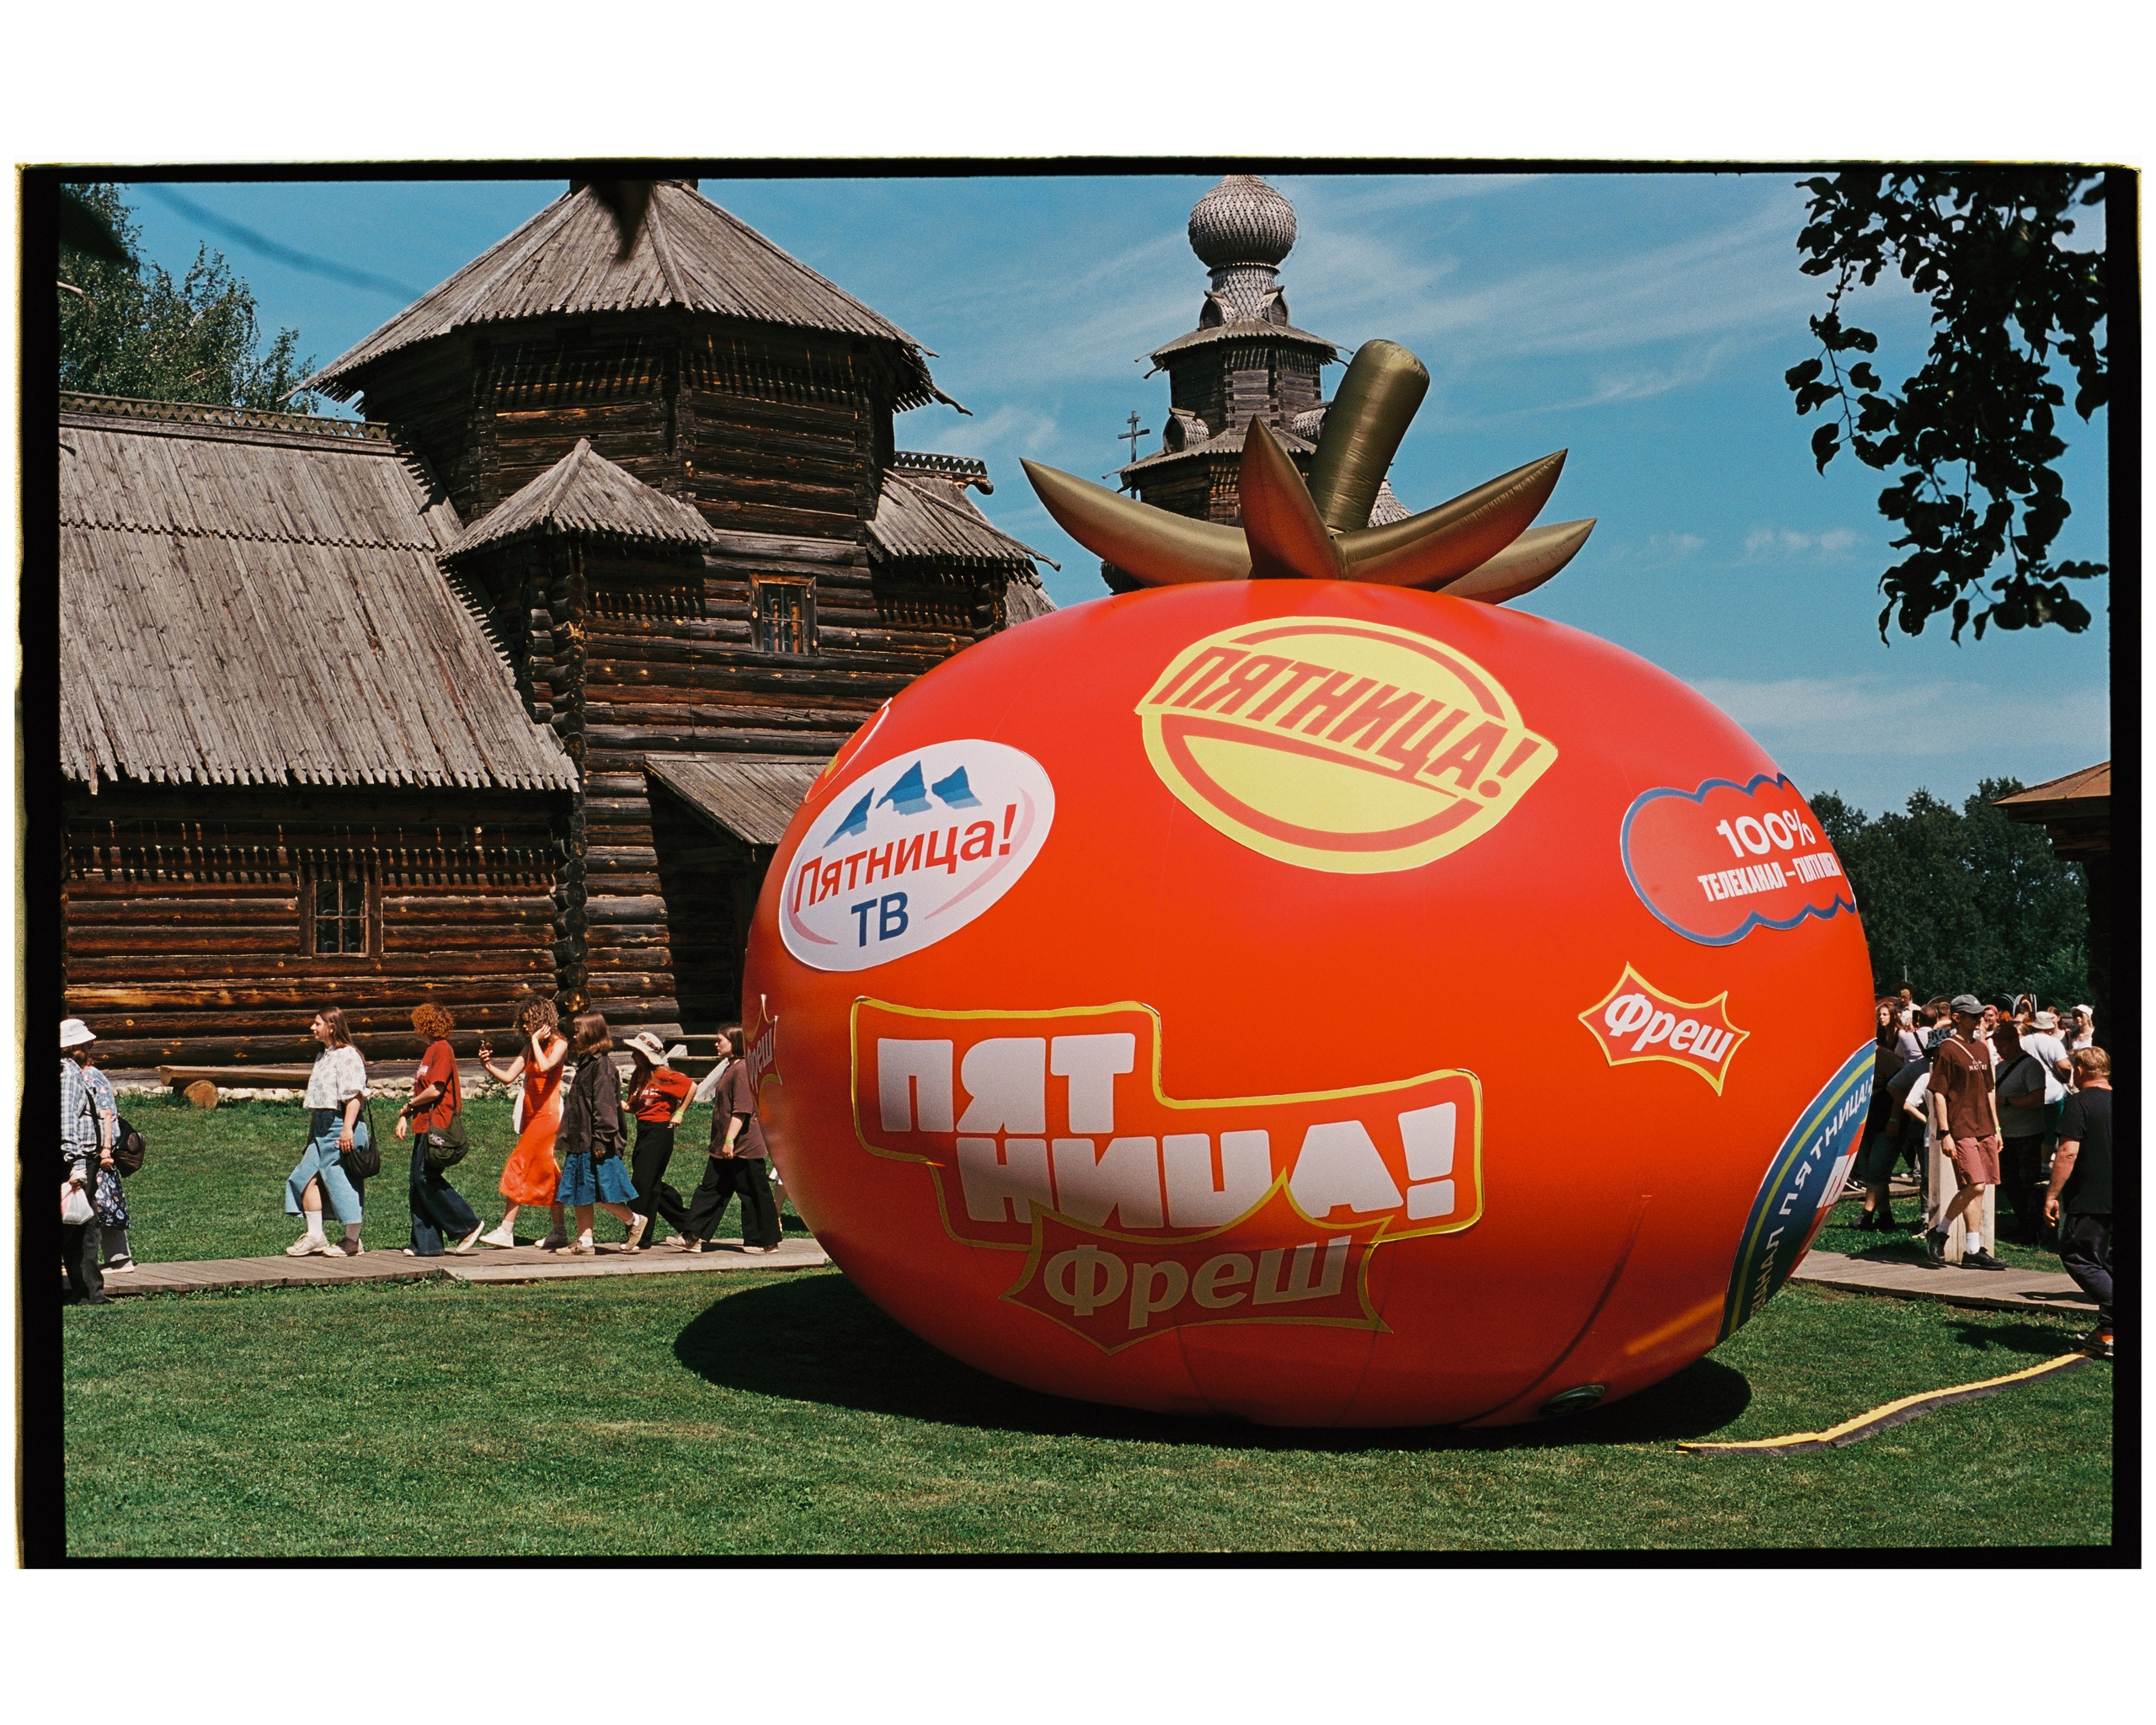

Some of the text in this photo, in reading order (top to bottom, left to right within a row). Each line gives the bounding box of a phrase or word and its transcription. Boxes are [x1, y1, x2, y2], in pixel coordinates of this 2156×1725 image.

[1148, 645, 1542, 799] ПЯТНИЦА!
[794, 804, 1017, 915] Пятница!
[1696, 861, 1788, 903] ТЕЛЕКАНАЛ
[1716, 809, 1817, 859] 100%
[850, 891, 910, 948] ТВ
[1604, 991, 1736, 1063] Фреш
[877, 1033, 1136, 1135] ПЯТ
[955, 1101, 1457, 1230] НИЦА!
[1043, 1234, 1353, 1331] Фреш
